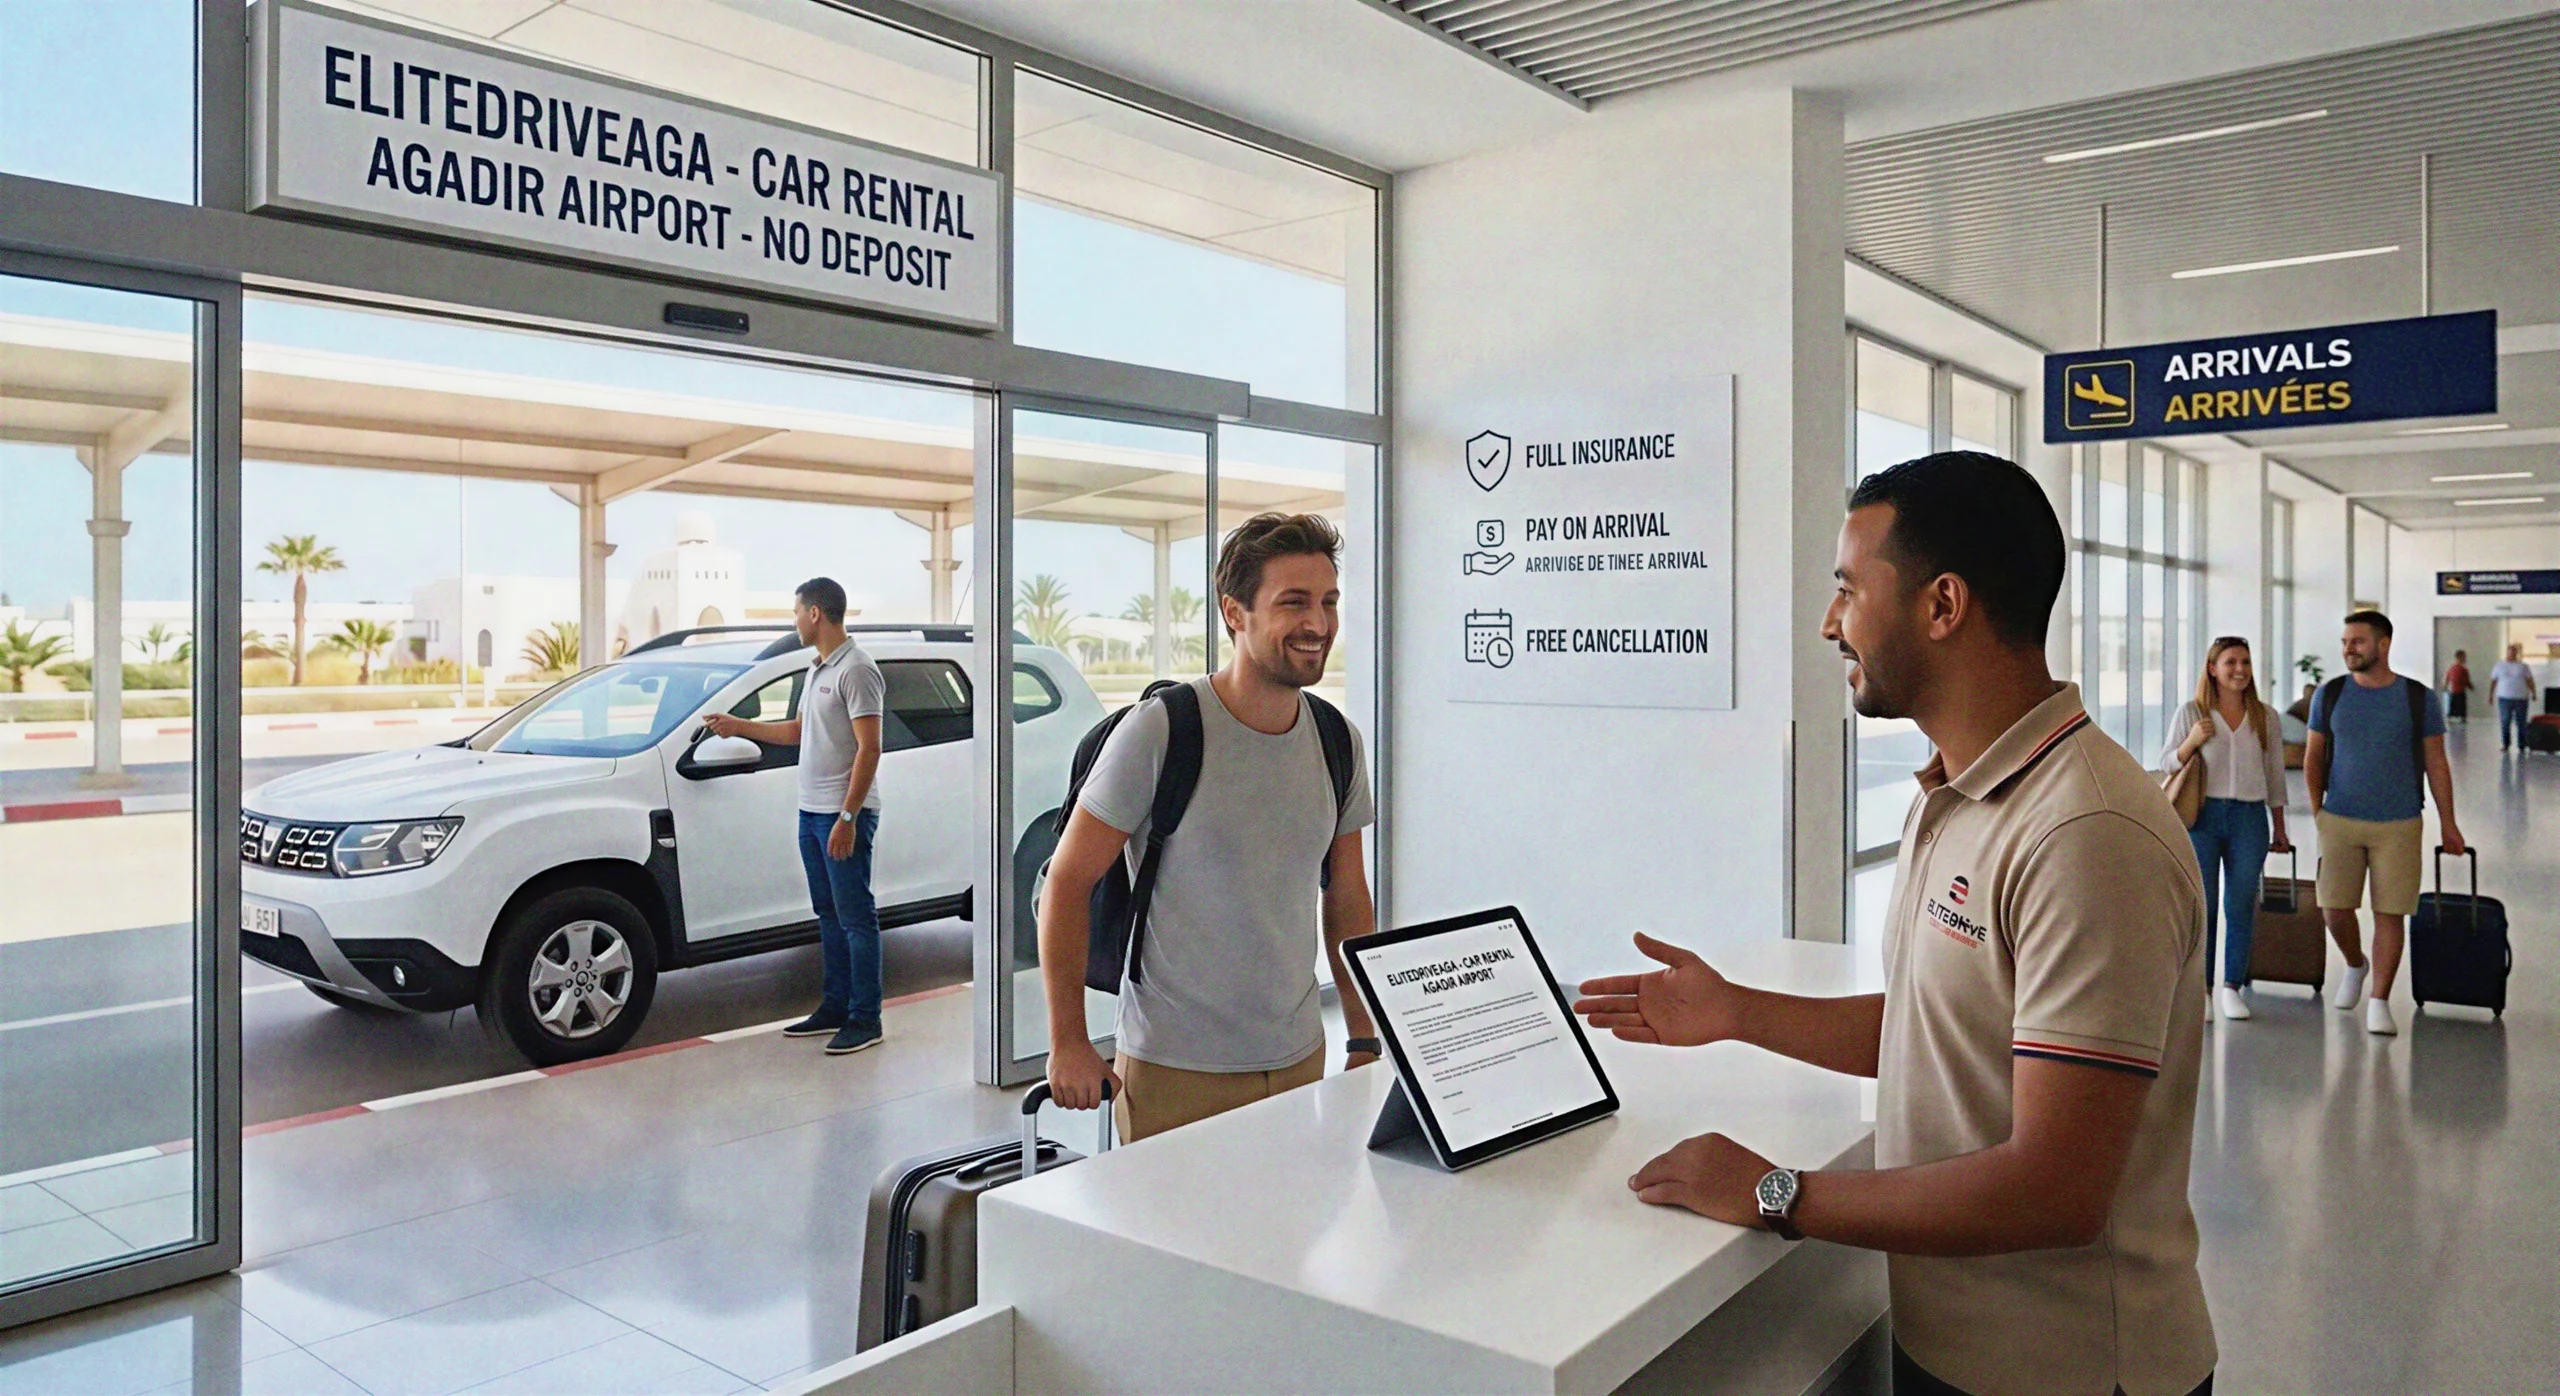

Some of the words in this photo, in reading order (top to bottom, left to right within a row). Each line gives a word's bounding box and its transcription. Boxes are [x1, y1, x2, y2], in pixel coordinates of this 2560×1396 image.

[325, 45, 714, 186] ELITEDRIVEAGA
[752, 147, 830, 211] CAR
[843, 167, 975, 241] RENTAL
[366, 136, 545, 217] AGADIR
[558, 175, 732, 250] AIRPORT
[763, 215, 810, 265] NO
[822, 227, 952, 291] DEPOSIT
[2164, 338, 2352, 383] ARRIVALS
[2164, 378, 2351, 422] ARRIVÉES
[1526, 442, 1567, 468] FULL
[1572, 433, 1675, 465] INSURANCE
[1526, 517, 1558, 542] PAY
[1563, 516, 1587, 540] ON
[1592, 511, 1671, 539] ARRIVAL
[1588, 554, 1605, 571] DE
[1607, 552, 1644, 571] TINEE
[1647, 550, 1708, 570] ARRIVAL
[1526, 629, 1568, 653] FREE
[1572, 628, 1708, 654] CANCELLATION
[1387, 960, 1460, 987] ELITEDRIVEAGA
[1462, 954, 1483, 969] CAR
[1481, 948, 1515, 966] RENTAL
[1422, 976, 1459, 995] AGADIR
[1459, 967, 1495, 987] AIRPORT
